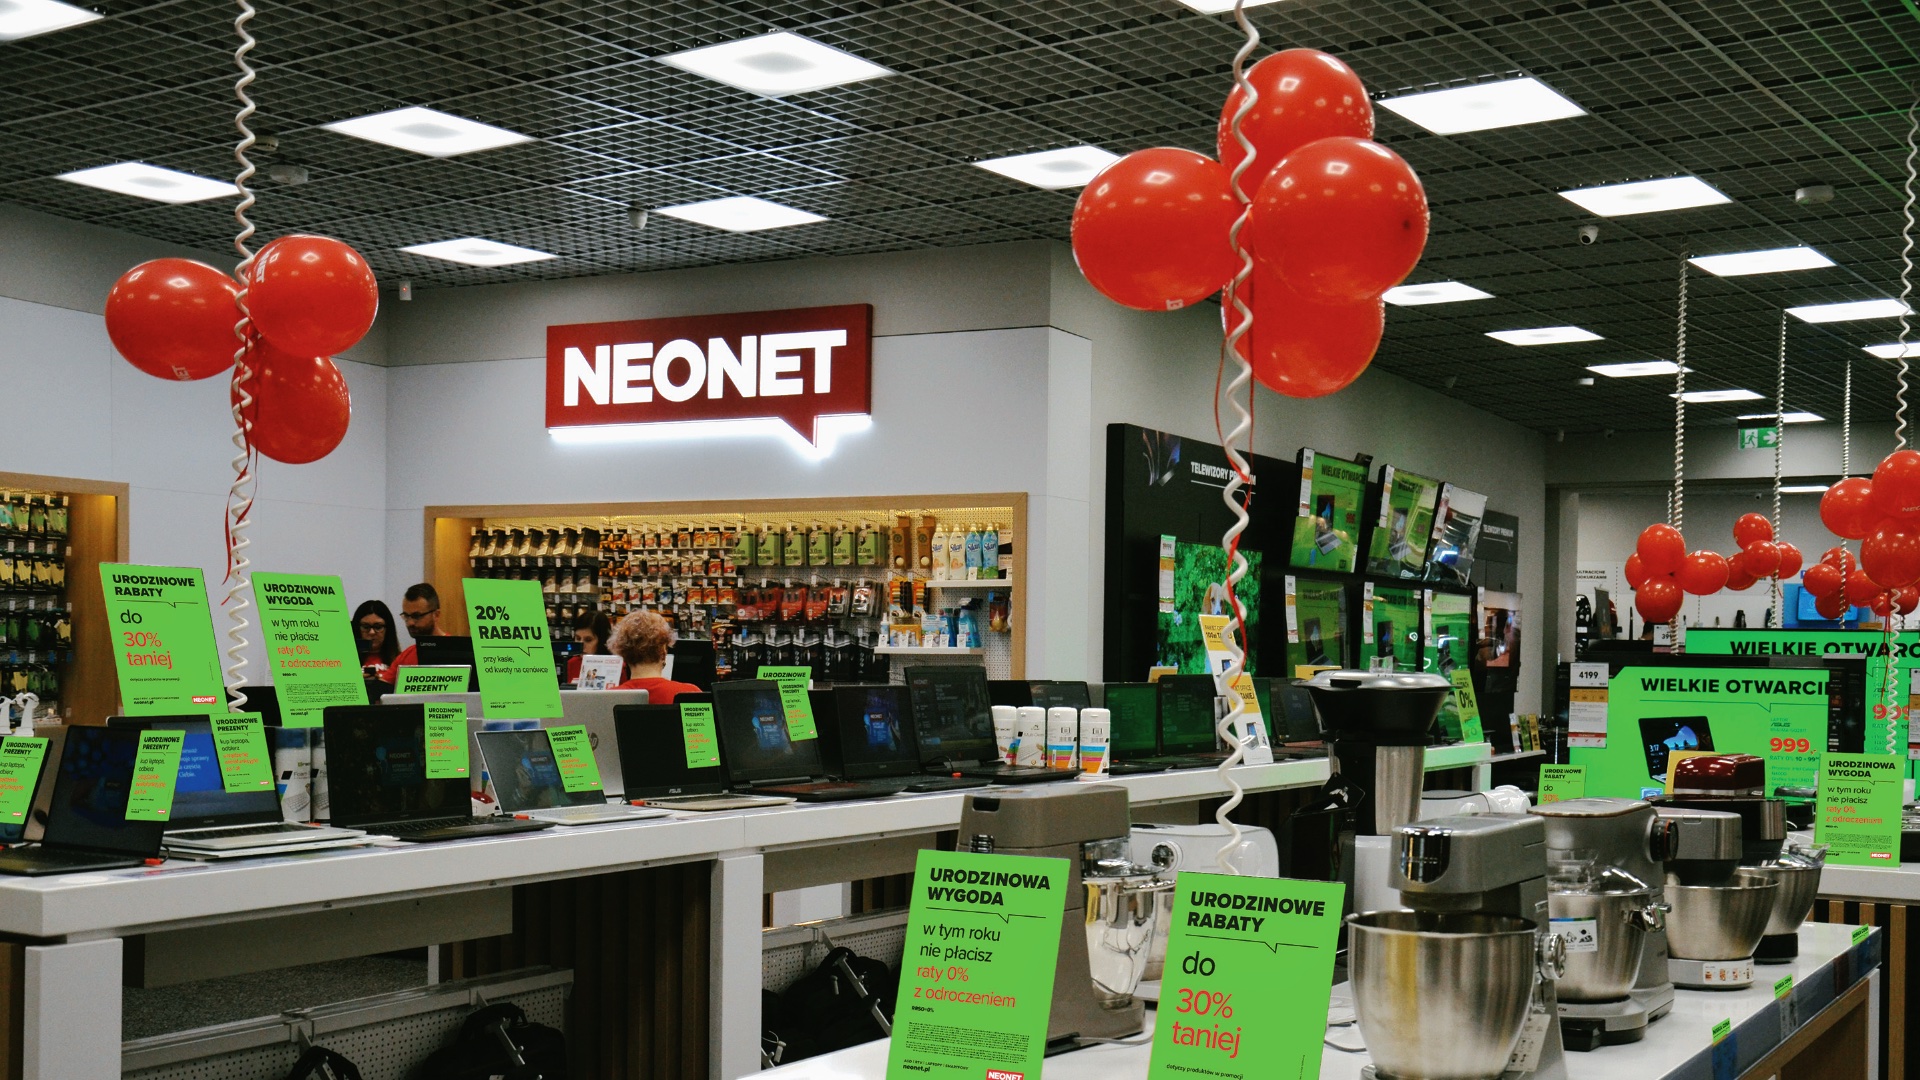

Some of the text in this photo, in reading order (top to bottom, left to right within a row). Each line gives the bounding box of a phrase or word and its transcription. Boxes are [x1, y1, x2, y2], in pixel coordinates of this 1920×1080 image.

[564, 330, 847, 407] NEONET
[1190, 461, 1229, 480] TELEWIZORY
[112, 574, 195, 587] URODZINOWE
[115, 586, 163, 597] RABATY
[264, 583, 336, 595] URODZINOWA
[266, 595, 314, 605] WYGODA
[120, 609, 142, 624] do
[475, 606, 510, 620] 20%
[271, 619, 320, 629] w tym roku
[123, 632, 162, 647] 30%
[275, 632, 320, 642] nie płacisz
[479, 626, 542, 640] RABATU
[278, 645, 310, 656] raty 0%
[1730, 641, 1817, 656] WIELKIE
[127, 651, 172, 670] taniej
[280, 659, 342, 668] z odroczeniem
[494, 666, 512, 674] kwoty
[1579, 671, 1599, 679] 4199
[406, 675, 463, 683] URODZINOWE
[1641, 678, 1720, 693] WIELKIE
[216, 717, 258, 725] URODZINOWE
[1828, 760, 1896, 770] URODZINOWA
[1828, 769, 1871, 778] WYGODA
[1542, 794, 1559, 802] 30%
[930, 867, 1051, 890] URODZINOWA
[927, 887, 1004, 906] WYGODA
[1190, 891, 1326, 917] URODZINOWE
[1187, 911, 1265, 932] RABATY
[923, 924, 1001, 942] w tym roku
[920, 944, 993, 962] nie płacisz
[1182, 951, 1216, 976] do
[917, 966, 969, 982] raty 0%
[914, 987, 1016, 1008] z odroczeniem
[1176, 988, 1233, 1018] 30%
[1172, 1021, 1242, 1059] taniej
[903, 1064, 930, 1072] neonet.pl
[1166, 1063, 1186, 1072] dotyczy
[1187, 1066, 1214, 1076] produktów
[1220, 1071, 1243, 1080] promocji
